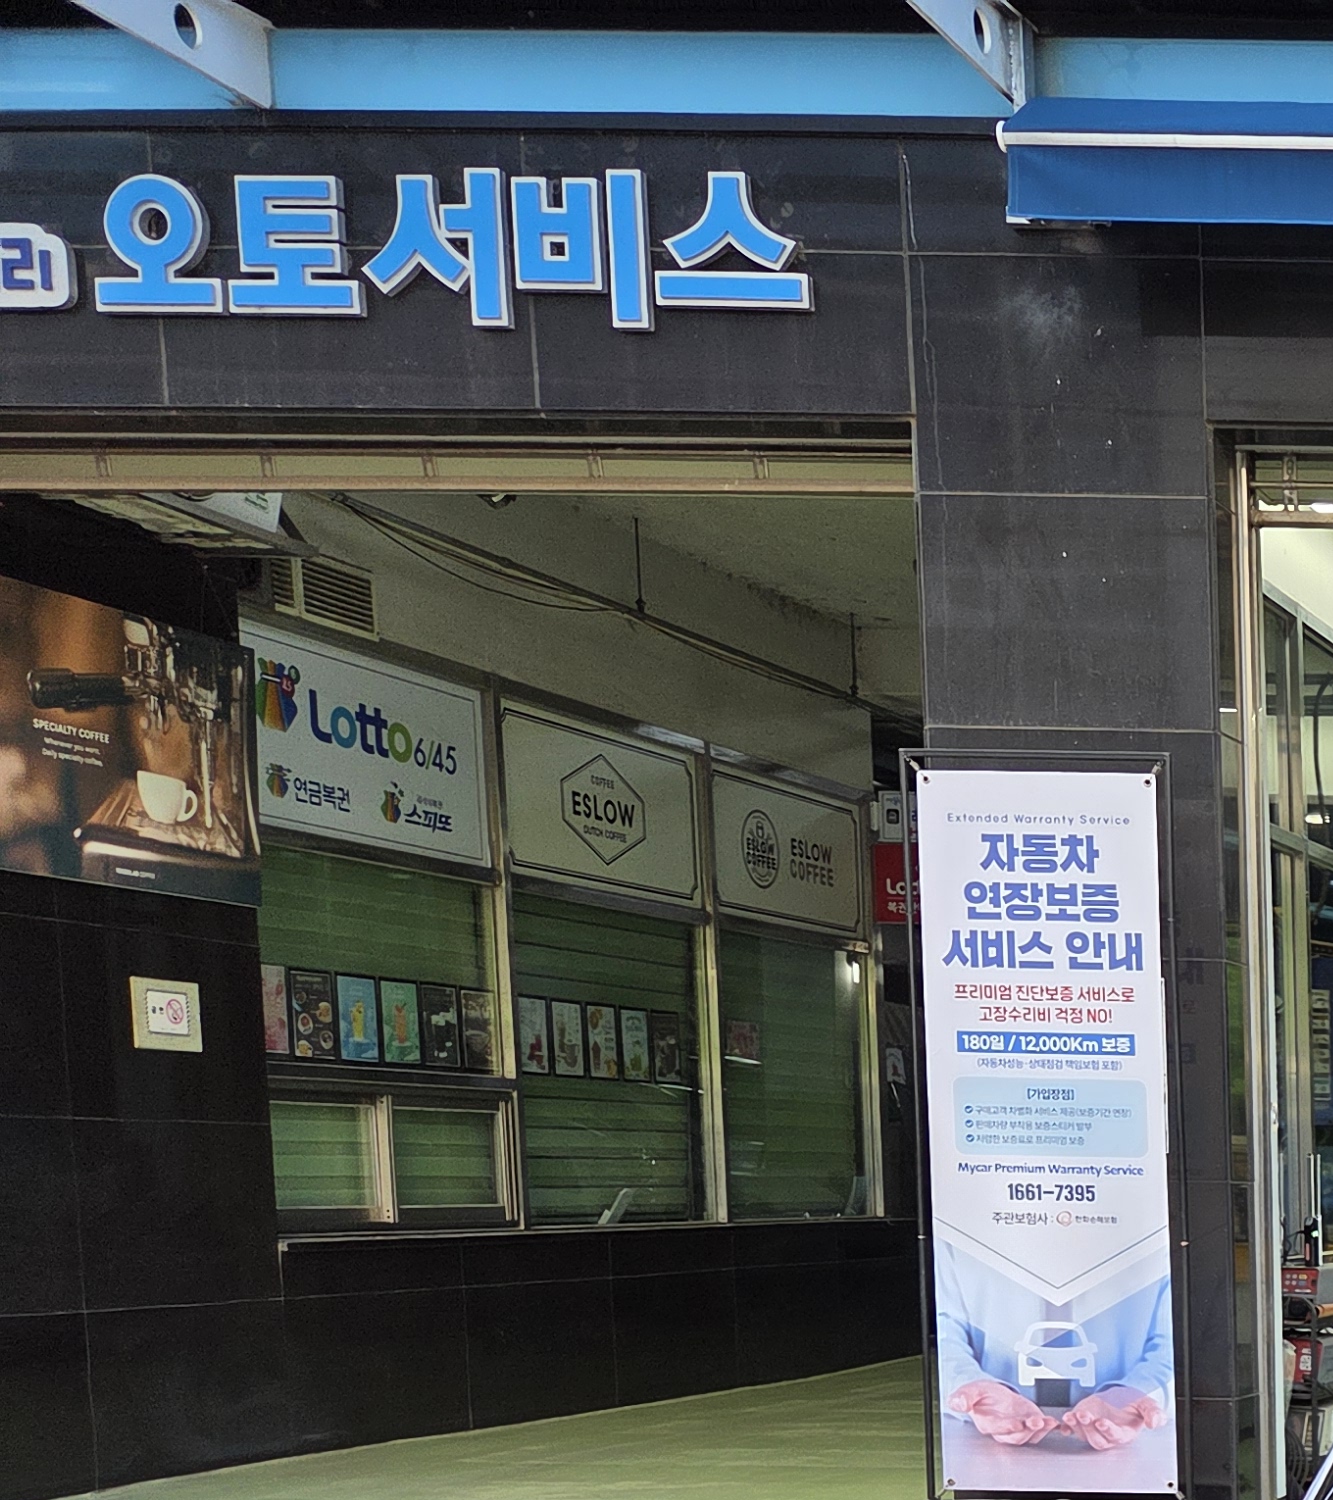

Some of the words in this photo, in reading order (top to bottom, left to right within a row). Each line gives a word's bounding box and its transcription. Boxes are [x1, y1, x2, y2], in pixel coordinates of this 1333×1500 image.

[95, 168, 812, 330] 오토서비스
[32, 718, 77, 736] SPECIALTY
[78, 728, 110, 744] COFFEE
[309, 688, 413, 763] Lotto
[413, 737, 457, 775] 6/45
[293, 777, 351, 813] 연금복권
[404, 803, 453, 833] 스피또
[571, 790, 635, 829] ESLOW
[947, 812, 1009, 824] Extended
[1013, 813, 1075, 826] Warranty
[1079, 815, 1131, 826] Service
[790, 837, 832, 865] ESLOW
[979, 833, 1100, 874] 자동차
[789, 858, 834, 888] COFFEE
[963, 881, 1120, 923] 연장보증
[941, 929, 1055, 969] 서비스
[1065, 931, 1144, 972] 안내
[954, 983, 1012, 1001] 프리미엄
[1015, 984, 1074, 1003] 진단보증
[1077, 986, 1136, 1003] 서비스로
[978, 1006, 1051, 1023] 고장수리비
[1054, 1007, 1084, 1024] 걱정
[1086, 1008, 1113, 1024] NO!
[961, 1034, 1005, 1051] 180일
[1019, 1035, 1099, 1053] 12,000Km
[1101, 1037, 1132, 1053] 보증
[1026, 1087, 1075, 1101] [가입장점]
[957, 1162, 993, 1175] Mycar
[994, 1163, 1046, 1174] Premium
[1047, 1164, 1102, 1178] Warranty
[1103, 1164, 1145, 1176] Service
[1007, 1183, 1096, 1202] 1661-7395
[992, 1212, 1049, 1225] 주관보험사
